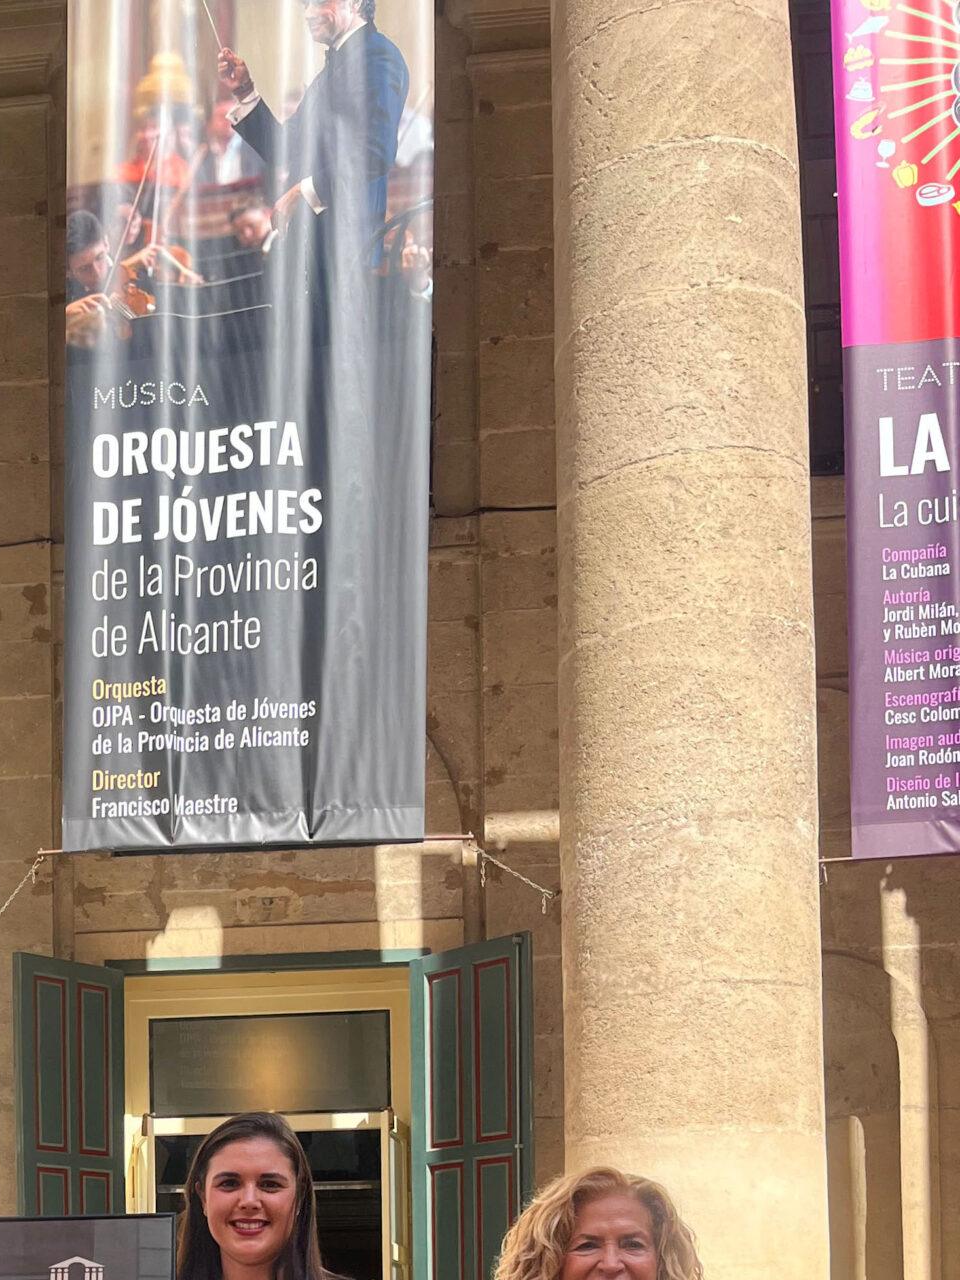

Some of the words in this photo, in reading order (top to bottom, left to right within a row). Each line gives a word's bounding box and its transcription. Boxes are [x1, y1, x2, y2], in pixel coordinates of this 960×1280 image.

[93, 380, 210, 410] MÚSICA
[92, 420, 304, 480] ORQUESTA
[878, 412, 951, 477] LA
[92, 498, 143, 545] DE
[153, 485, 323, 543] JÓVENES
[878, 493, 908, 528] La
[917, 489, 958, 525] cui
[882, 543, 947, 563] Compañía
[92, 559, 128, 601] de
[139, 554, 163, 598] la
[175, 552, 318, 598] Provincia
[882, 565, 897, 581] La
[900, 562, 951, 579] Cubana
[883, 587, 931, 605] Autoría
[883, 606, 915, 623] Jordi
[92, 616, 128, 657] de
[138, 609, 262, 656] Alicante
[883, 628, 891, 643] y
[884, 648, 930, 665] Música
[884, 666, 925, 683] Albert
[92, 675, 167, 703] Orquesta
[92, 705, 134, 728] OJPA
[150, 701, 221, 727] Orquesta
[226, 700, 246, 722] de
[251, 697, 316, 720] Jóvenes
[885, 709, 916, 725] Cesc
[92, 735, 112, 755] de
[117, 732, 132, 754] la
[138, 730, 209, 753] Provincia
[214, 728, 234, 750] de
[240, 726, 309, 748] Alicante
[886, 734, 934, 752] Imagen
[885, 752, 915, 768] Joan
[92, 769, 161, 791] Director
[886, 775, 930, 792] Diseño
[935, 773, 951, 789] de
[92, 796, 170, 819] Francisco
[886, 793, 937, 810] Antonio
